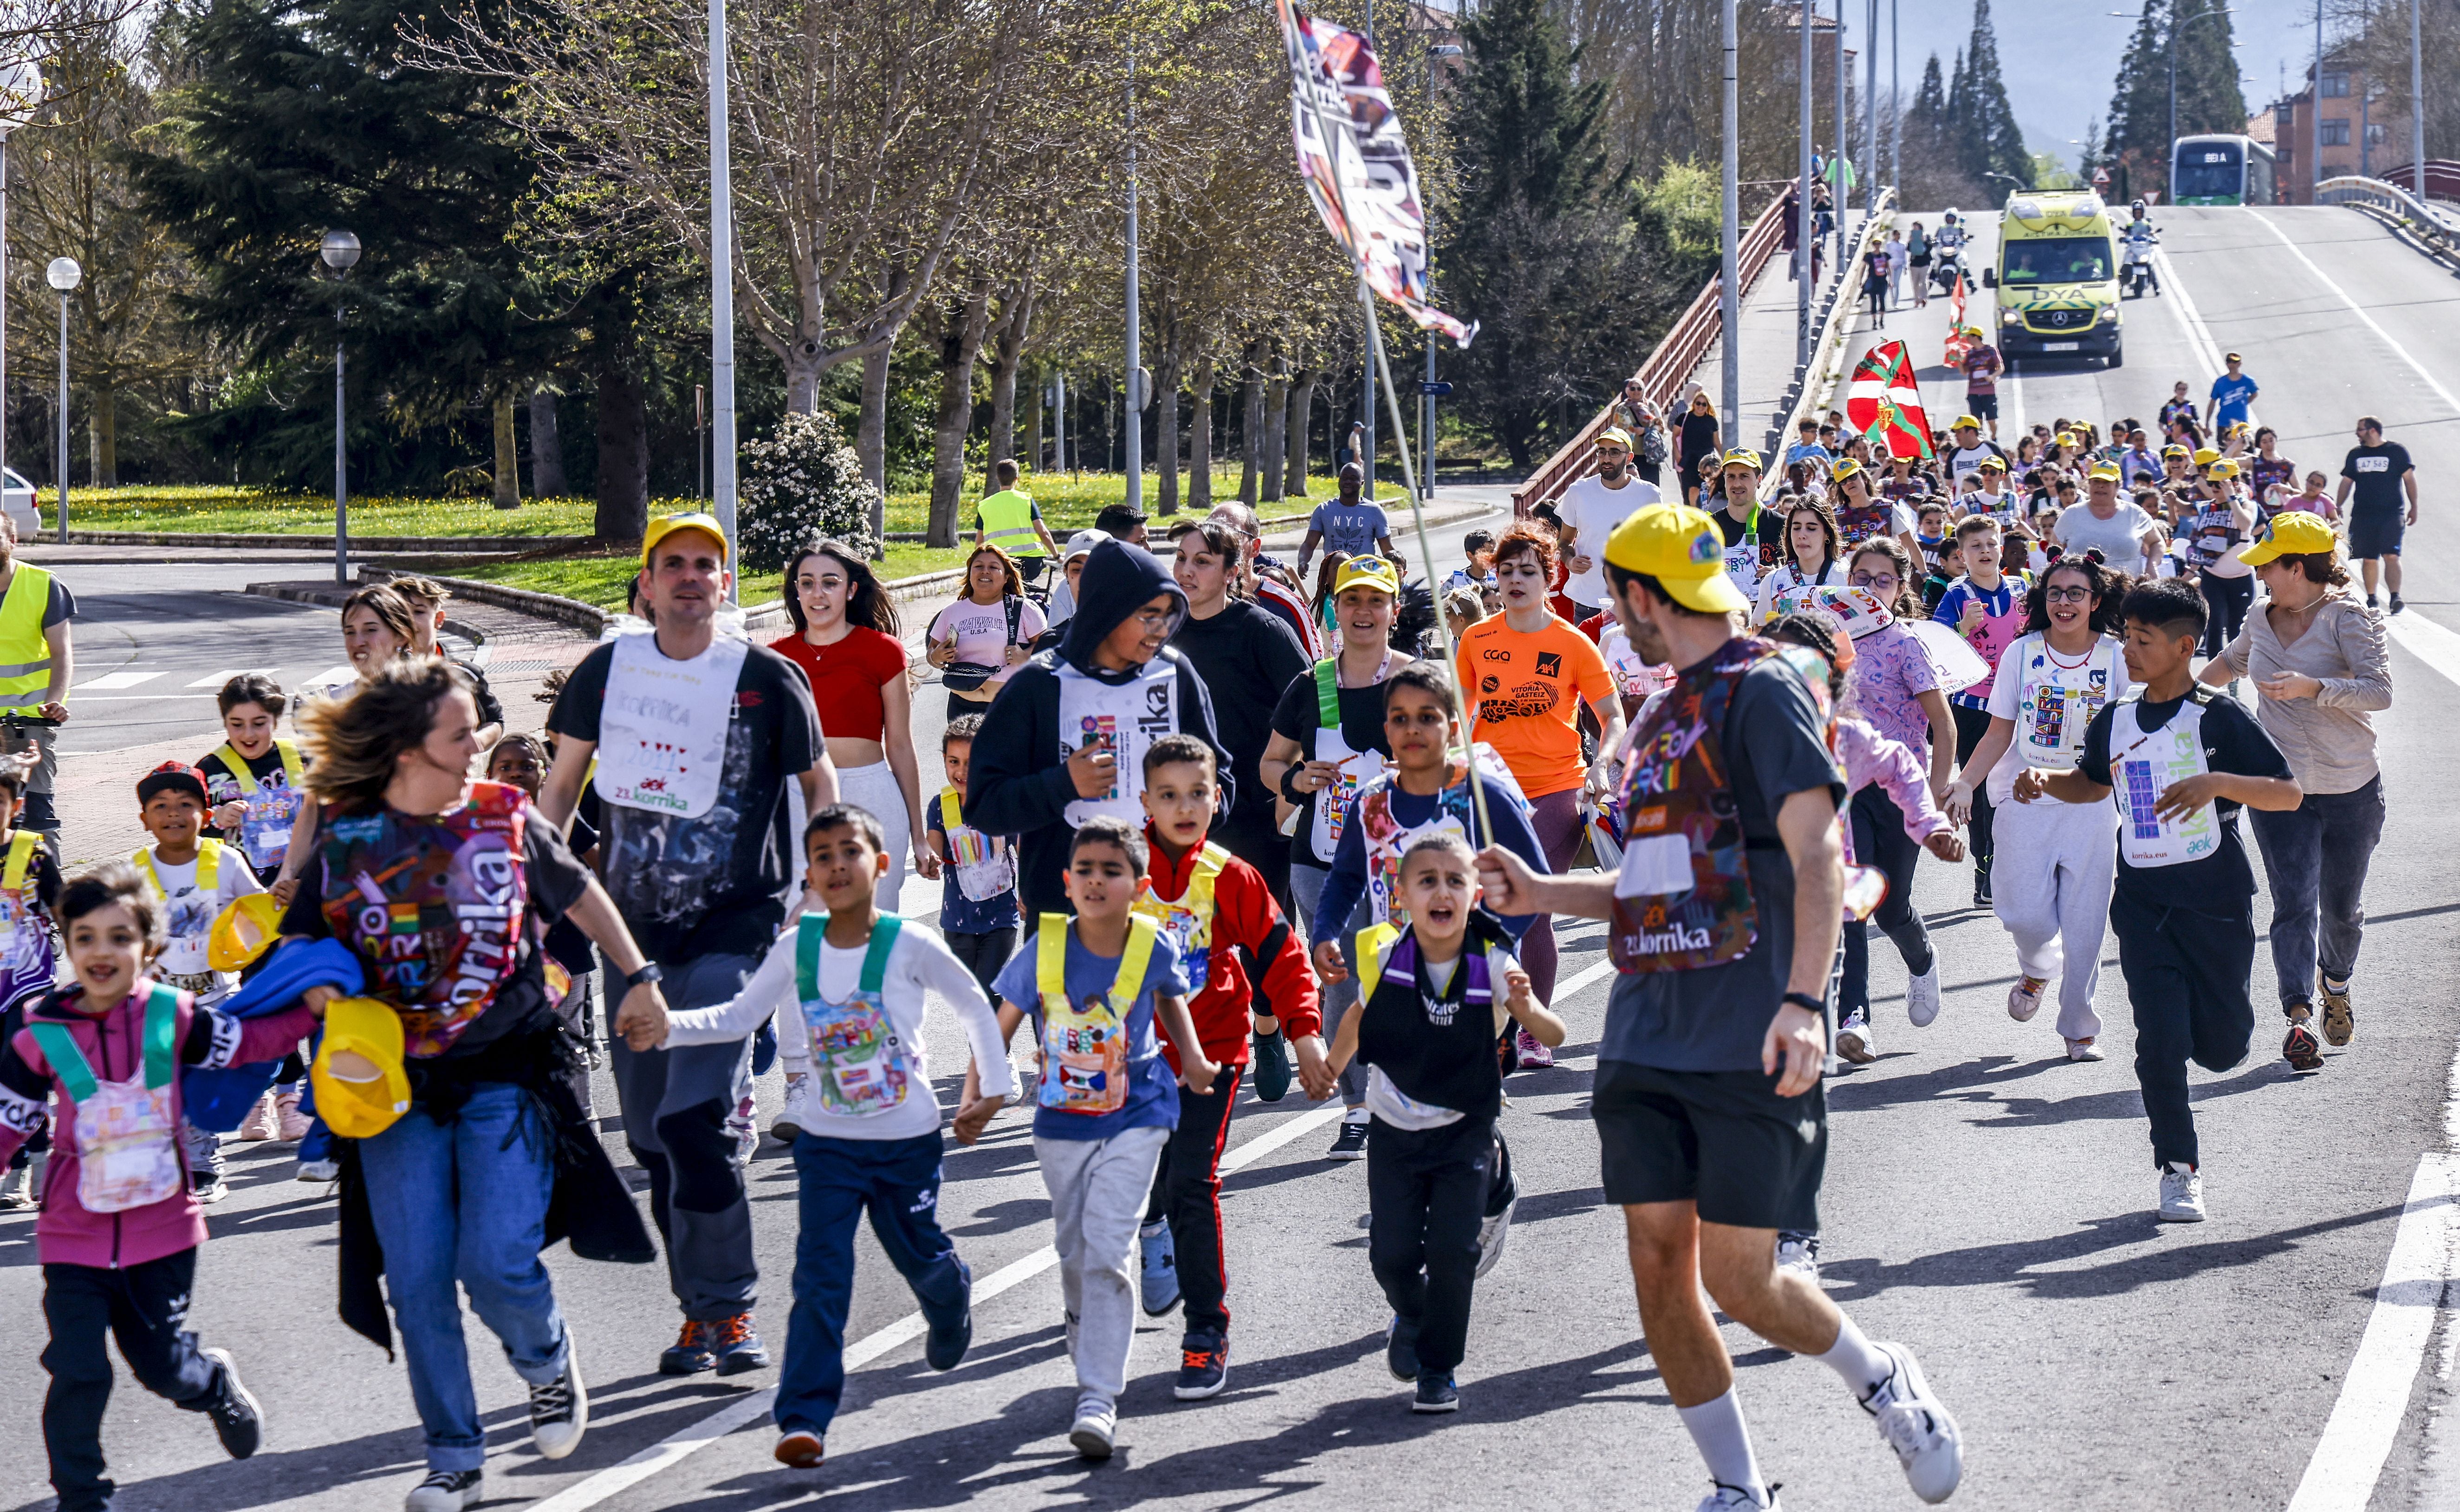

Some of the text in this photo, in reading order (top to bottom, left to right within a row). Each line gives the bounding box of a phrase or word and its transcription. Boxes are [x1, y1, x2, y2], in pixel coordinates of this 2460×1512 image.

[2032, 289, 2085, 301] DYA
[1333, 516, 1364, 527] NYC
[957, 616, 1003, 633] HAWAII
[1536, 663, 1554, 675] AXA
[1483, 682, 1496, 690] FRENO
[2187, 833, 2213, 854] aek
[450, 848, 513, 1005] orrika
